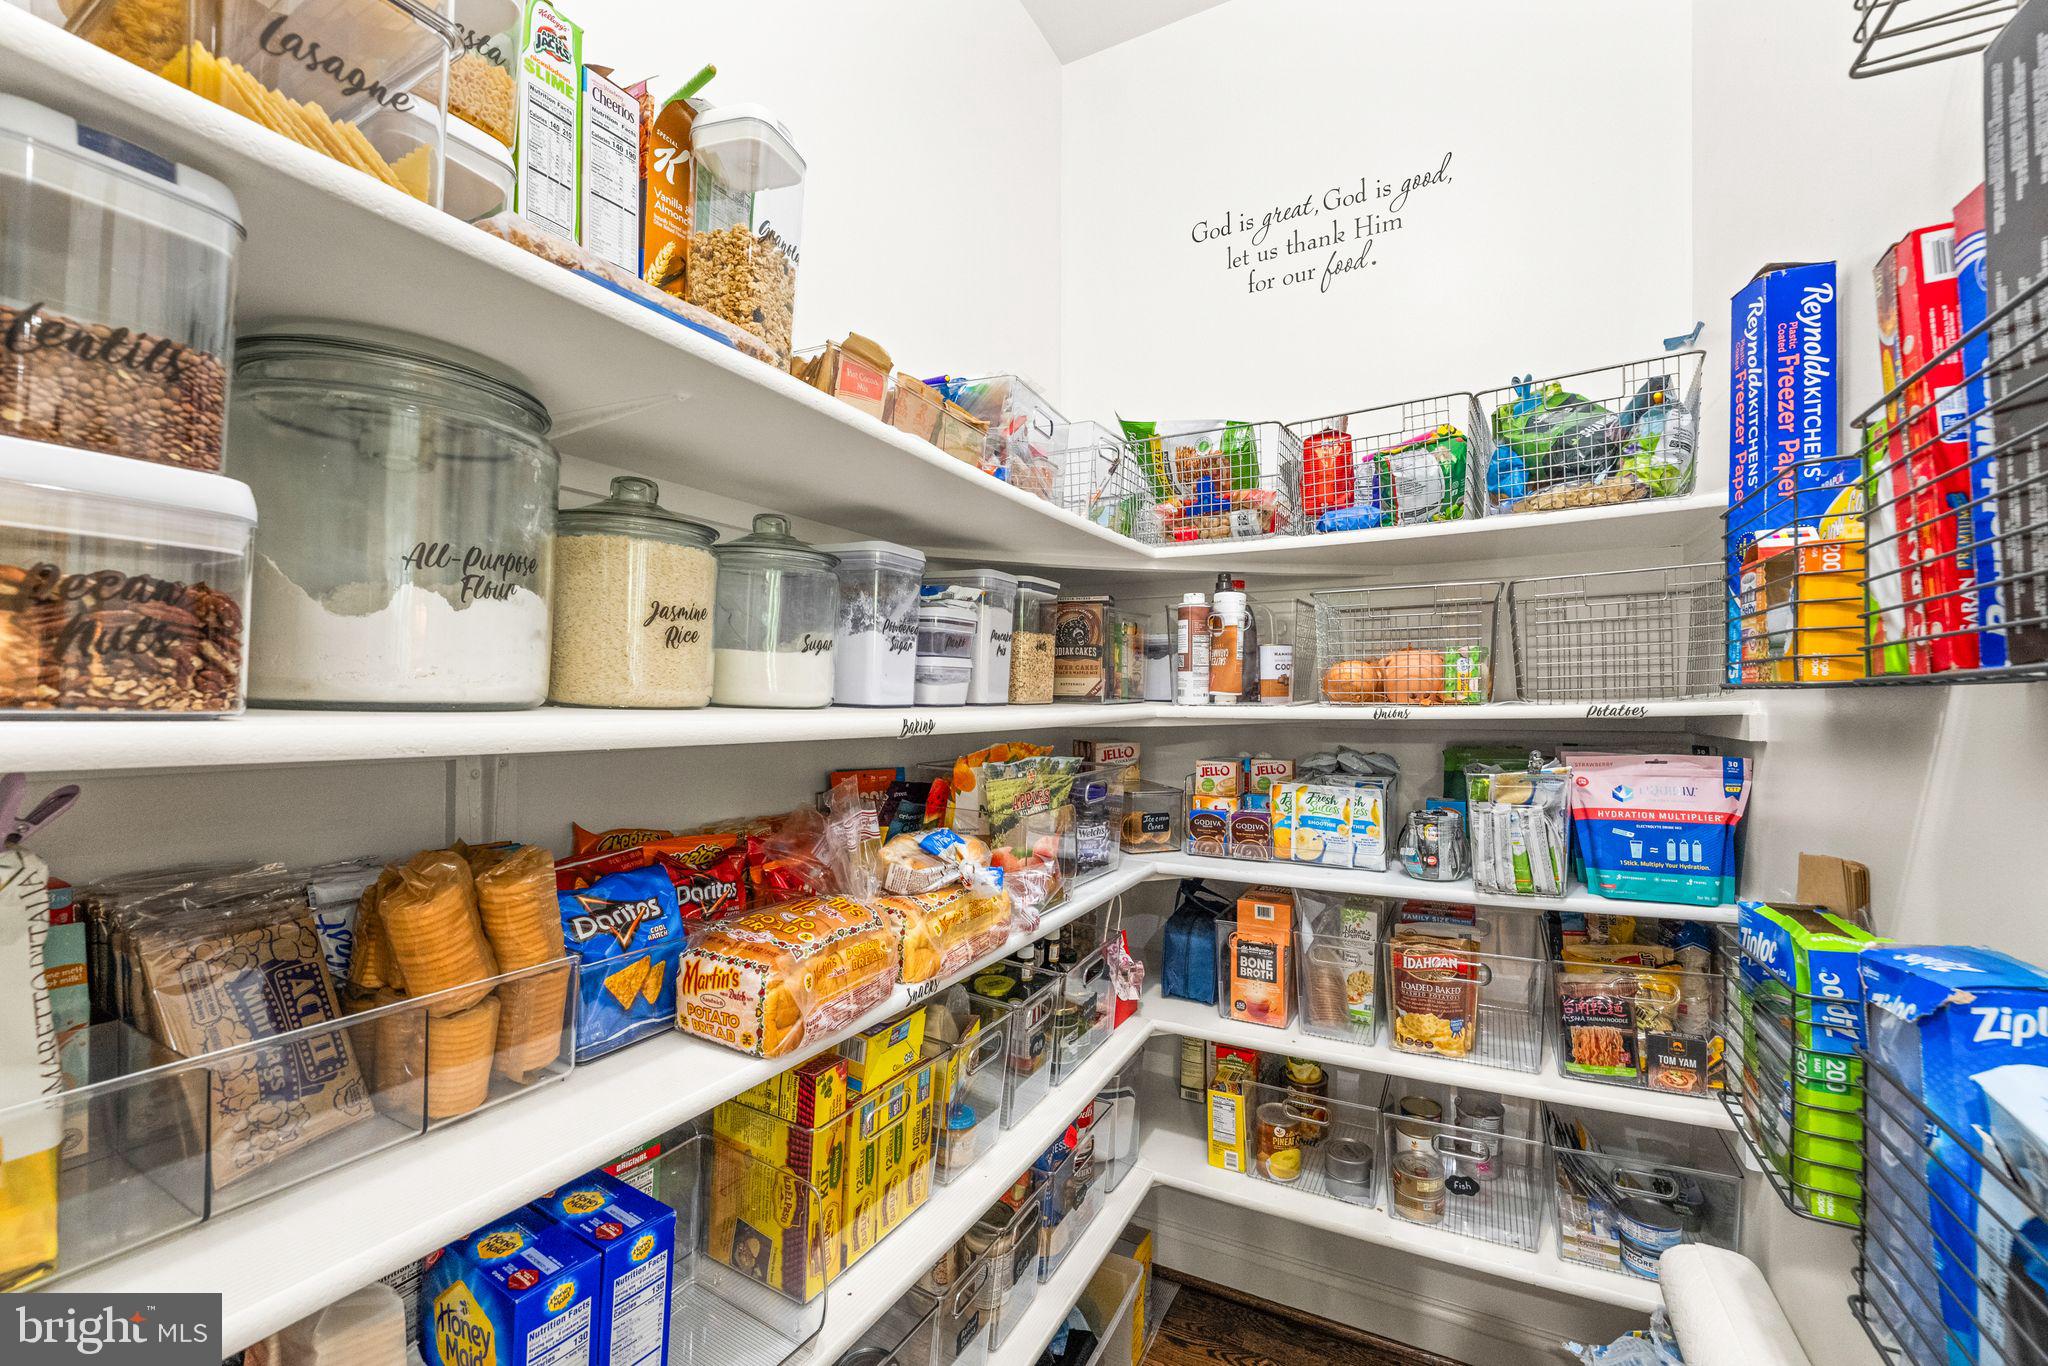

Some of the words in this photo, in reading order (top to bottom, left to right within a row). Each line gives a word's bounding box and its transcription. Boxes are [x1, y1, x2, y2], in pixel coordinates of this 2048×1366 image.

[538, 8, 569, 32] Kellogg's
[455, 22, 506, 66] asta
[535, 35, 571, 61] JACKS
[259, 15, 415, 113] Lasagne
[523, 57, 575, 101] SLIME
[529, 85, 556, 106] Nutrition
[556, 102, 573, 116] Facts
[591, 87, 635, 124] Cheerios
[591, 107, 618, 126] Nutrition
[549, 121, 560, 132] 140
[562, 127, 573, 139] 210
[656, 128, 679, 149] SPECIAL
[612, 142, 624, 153] 140
[625, 149, 637, 160] 190
[653, 186, 683, 212] Vanilla
[1191, 212, 1232, 243] God
[1240, 213, 1254, 233] is
[1251, 195, 1320, 247] great,
[1322, 178, 1367, 211] God
[1376, 180, 1392, 198] is
[1389, 151, 1453, 213] good,
[758, 219, 800, 264] Granola
[1227, 247, 1250, 269] let
[1257, 247, 1278, 263] us
[1286, 220, 1346, 256] thank
[1354, 215, 1403, 241] Him
[1248, 270, 1275, 293] for
[1282, 267, 1316, 287] our
[1320, 239, 1378, 293] food.
[1777, 322, 1787, 354] Coated
[1788, 320, 1799, 349] Plastic
[1777, 353, 1800, 433] Freezer
[1735, 370, 1748, 447] Freezer
[1773, 437, 1800, 500] Paper
[402, 542, 539, 578] All-Purpose
[1821, 543, 1842, 571] 200
[461, 573, 518, 603] Flour
[643, 600, 709, 628] Jasmine
[664, 625, 700, 649] Rice
[800, 632, 834, 655] Sugar
[889, 635, 914, 656] Sugar
[1075, 646, 1097, 657] CAKES
[1373, 708, 1411, 721] Onions
[1586, 705, 1649, 719] Potatoes
[900, 717, 936, 740] Baking
[1727, 760, 1739, 768] 30
[1305, 791, 1338, 806] Fresh
[1307, 801, 1340, 815] Success
[1194, 818, 1222, 827] GODIVA
[1235, 822, 1265, 831] GODIVA
[1307, 820, 1337, 828] SMOOTHIE
[1597, 810, 1656, 820] HYDRATION
[1078, 825, 1106, 839] Welch's
[1623, 859, 1639, 867] Stick.
[1640, 860, 1664, 869] Multiply
[1679, 862, 1711, 871] Hydration.
[677, 881, 738, 906] Doritos
[574, 897, 662, 940] Doritos
[650, 924, 666, 934] COOL
[1402, 913, 1431, 922] FAMILY
[1431, 915, 1449, 923] SIZE
[647, 930, 669, 941] RANCH
[1240, 955, 1274, 971] BONE
[1240, 967, 1274, 981] BROTH
[1403, 956, 1458, 970] IDAHOAN
[682, 958, 742, 996] Martin's
[1400, 981, 1434, 994] LOADED
[1434, 983, 1462, 995] BAKED
[906, 978, 941, 1006] Snacks
[238, 982, 273, 1034] Mini
[686, 1001, 740, 1029] POTATO
[691, 1018, 736, 1043] BREAD
[1606, 1016, 1629, 1024] NOODLE
[30, 970, 62, 1110] MARETTO
[1658, 1054, 1676, 1066] TOM
[1678, 1057, 1697, 1068] YAM
[1825, 1060, 1848, 1093] 200
[914, 1110, 922, 1137] SHELLS
[912, 1136, 920, 1151] 10
[616, 1152, 648, 1173] ORIGINAL
[884, 1158, 893, 1172] 12
[819, 1168, 830, 1199] KIT
[856, 1178, 864, 1194] 12
[1453, 1180, 1472, 1190] Fish
[566, 1199, 591, 1212] Maid
[572, 1193, 600, 1208] Honey
[480, 1241, 503, 1255] Maid
[487, 1234, 519, 1250] Honey
[614, 1264, 647, 1288] Nutrition
[647, 1253, 667, 1269] Facts
[651, 1281, 666, 1295] 130
[529, 1312, 567, 1341] Nutrition
[568, 1299, 590, 1319] Facts
[613, 1301, 638, 1319] Calories
[437, 1302, 491, 1359] Honey
[573, 1330, 589, 1346] 130
[445, 1333, 483, 1366] Maid
